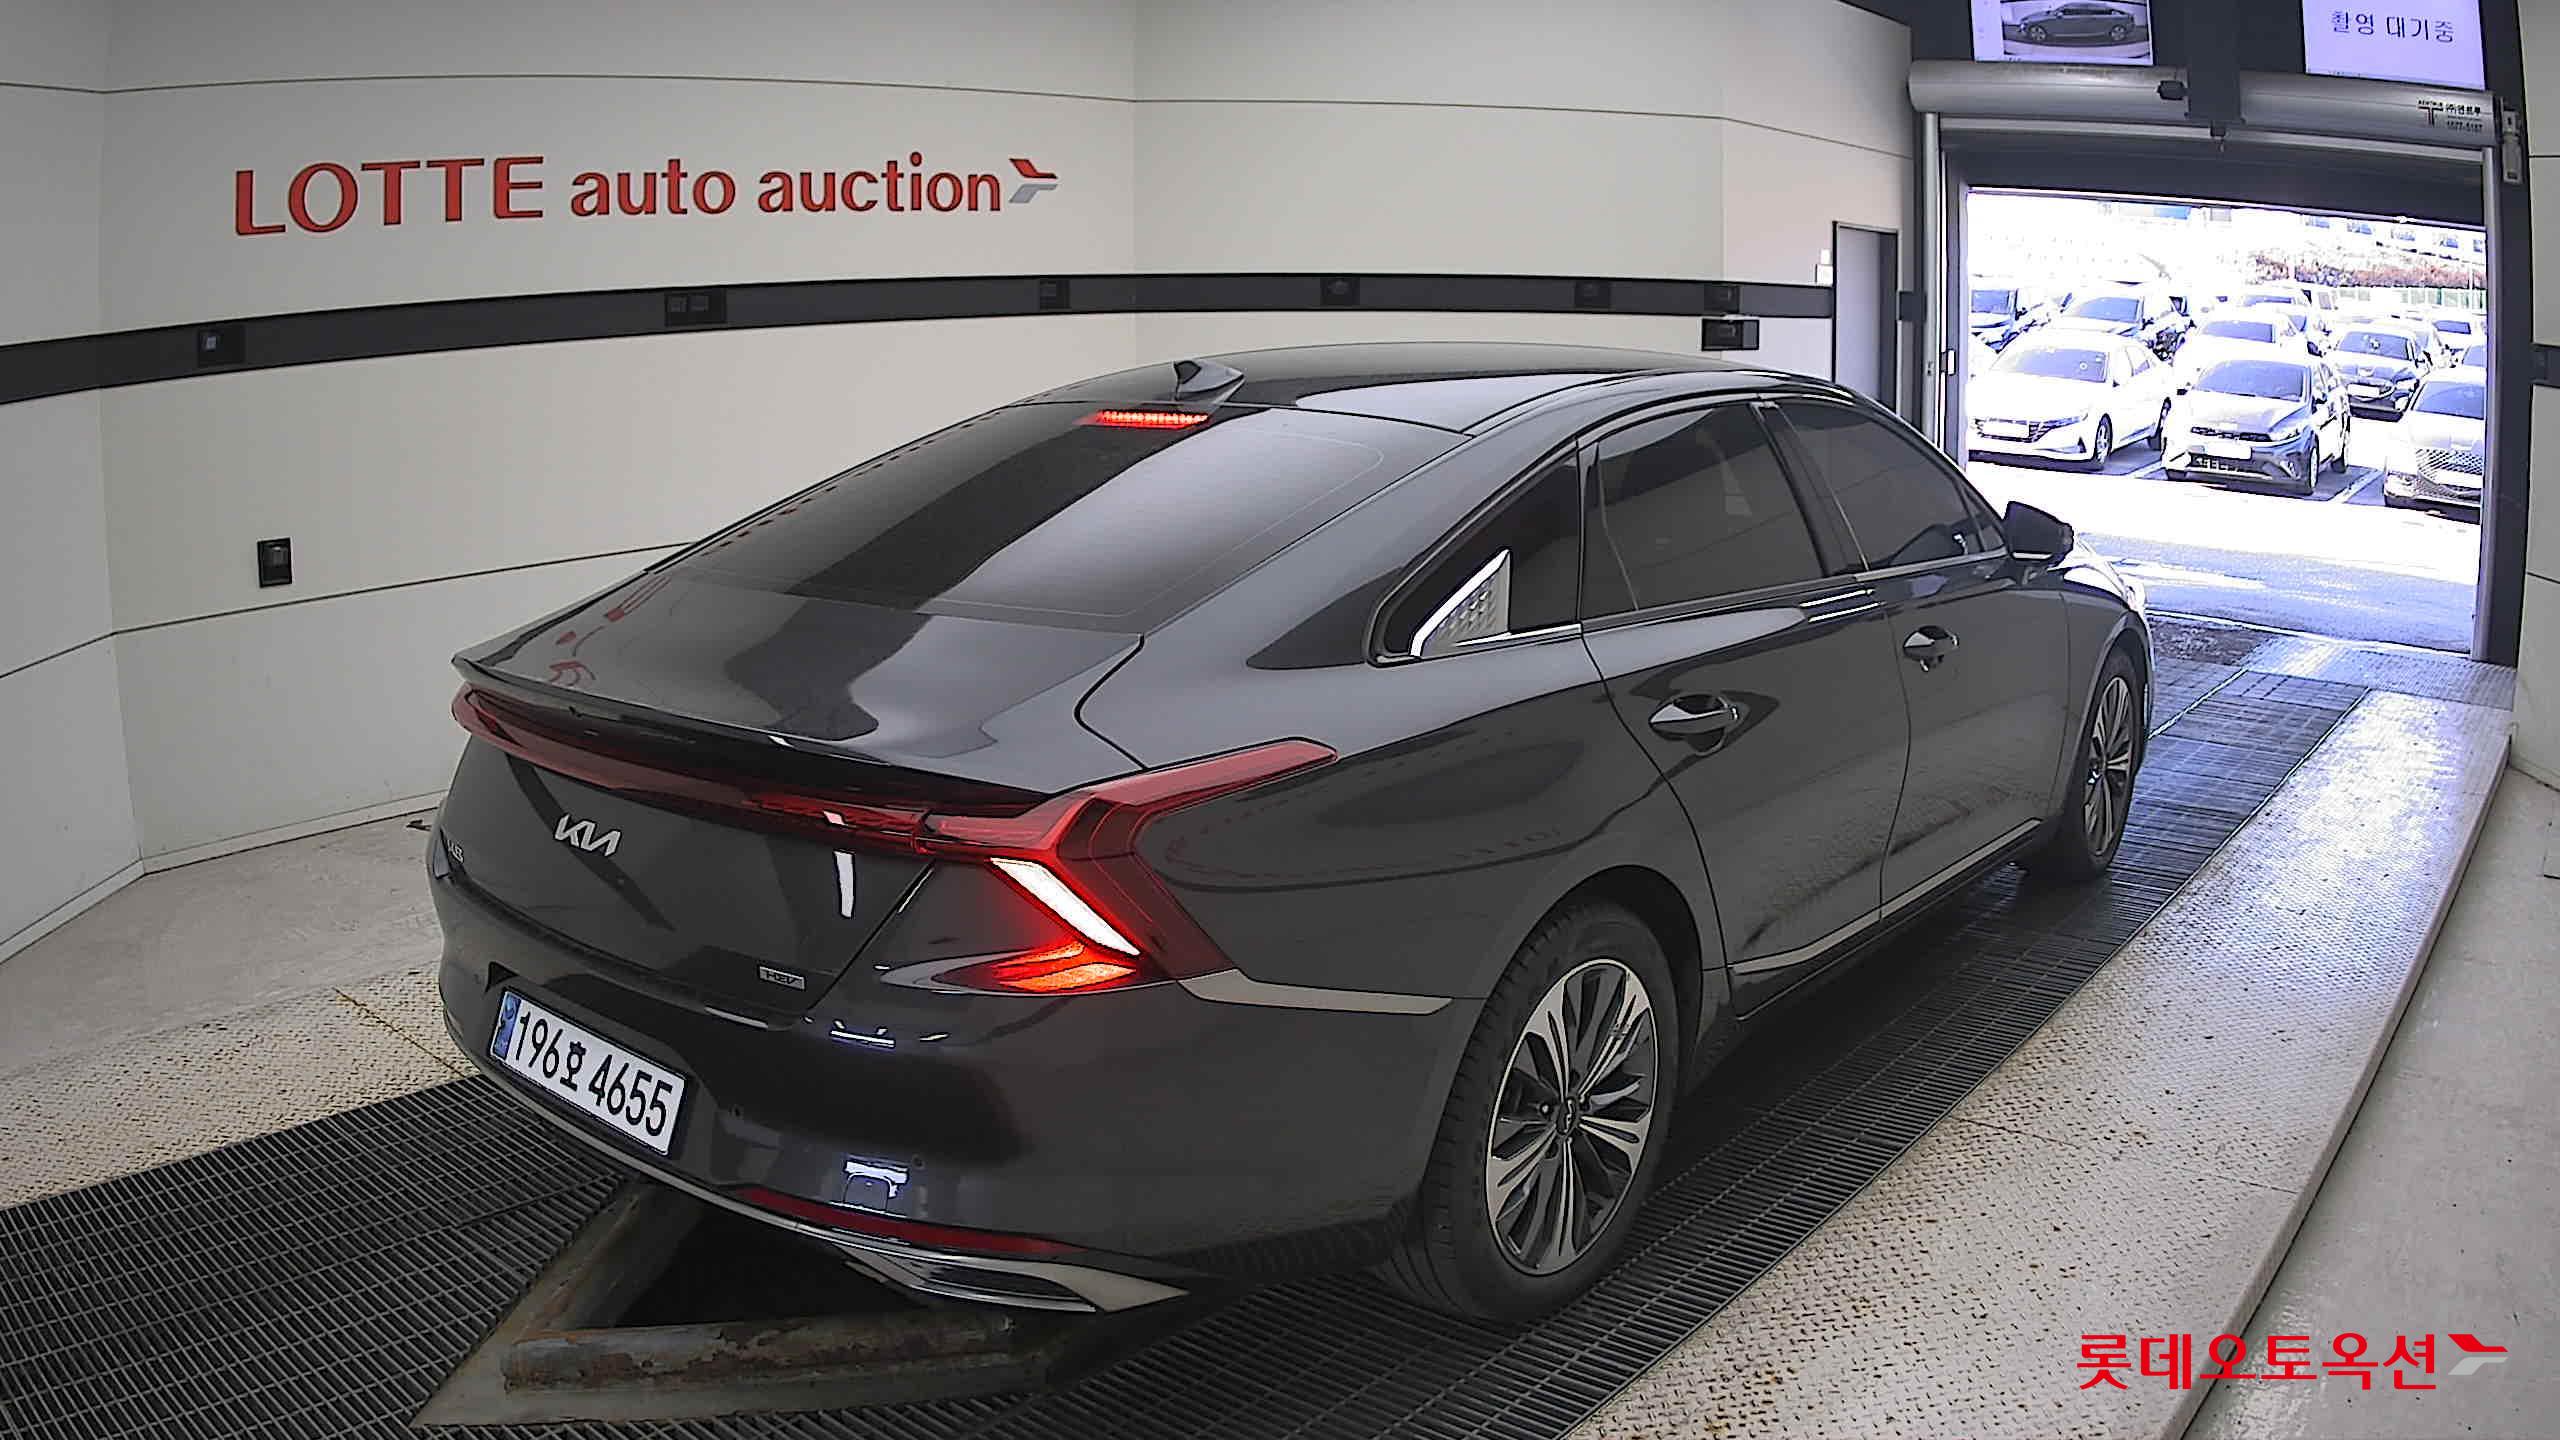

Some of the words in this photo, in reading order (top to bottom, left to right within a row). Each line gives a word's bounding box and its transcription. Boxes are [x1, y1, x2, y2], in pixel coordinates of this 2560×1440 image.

[2331, 9, 2375, 36] 촬영
[2387, 16, 2456, 44] 대기중
[235, 156, 544, 236] LOTTE
[570, 158, 739, 218] auto
[756, 151, 1003, 214] auction
[515, 1010, 588, 1092] 196호
[588, 1053, 673, 1138] 4655
